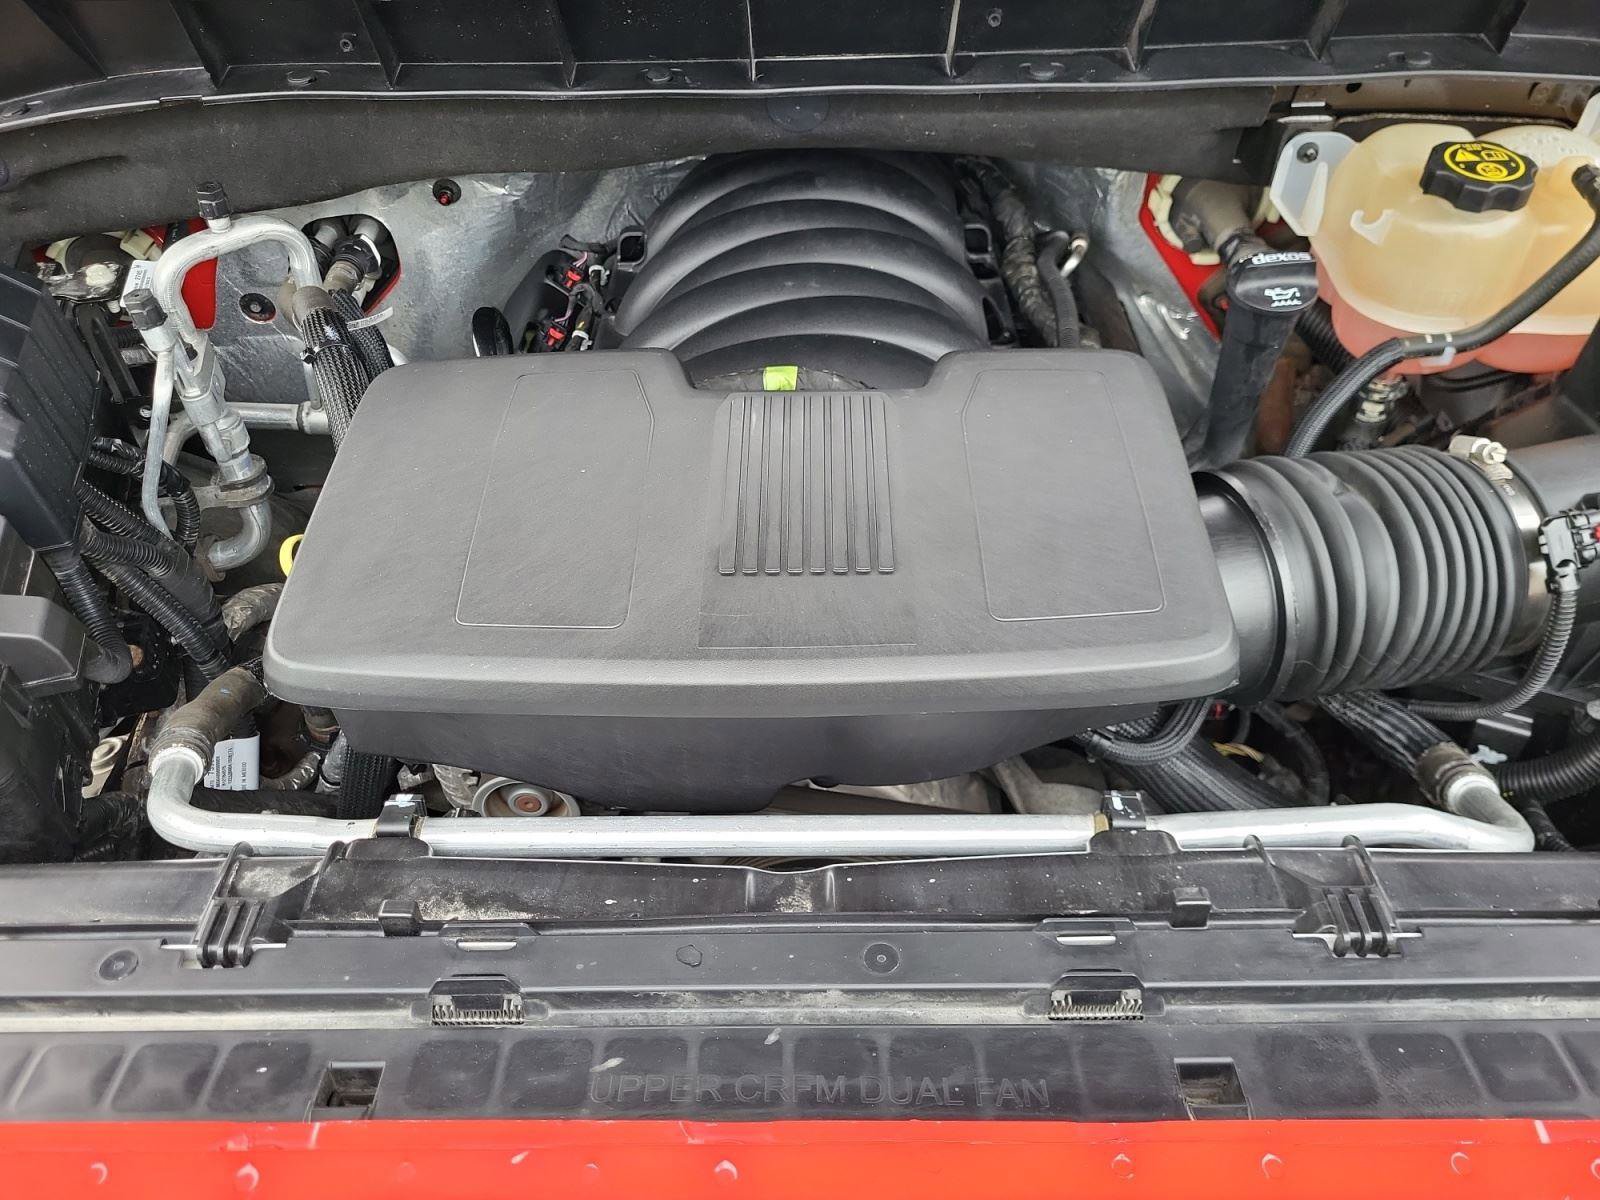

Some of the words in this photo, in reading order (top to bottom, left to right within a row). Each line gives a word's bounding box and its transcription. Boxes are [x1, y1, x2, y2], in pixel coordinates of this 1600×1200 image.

[1251, 251, 1312, 265] dexos
[589, 1073, 722, 1103] UPPER
[858, 1075, 964, 1106] DUAL
[973, 1077, 1050, 1108] FAN
